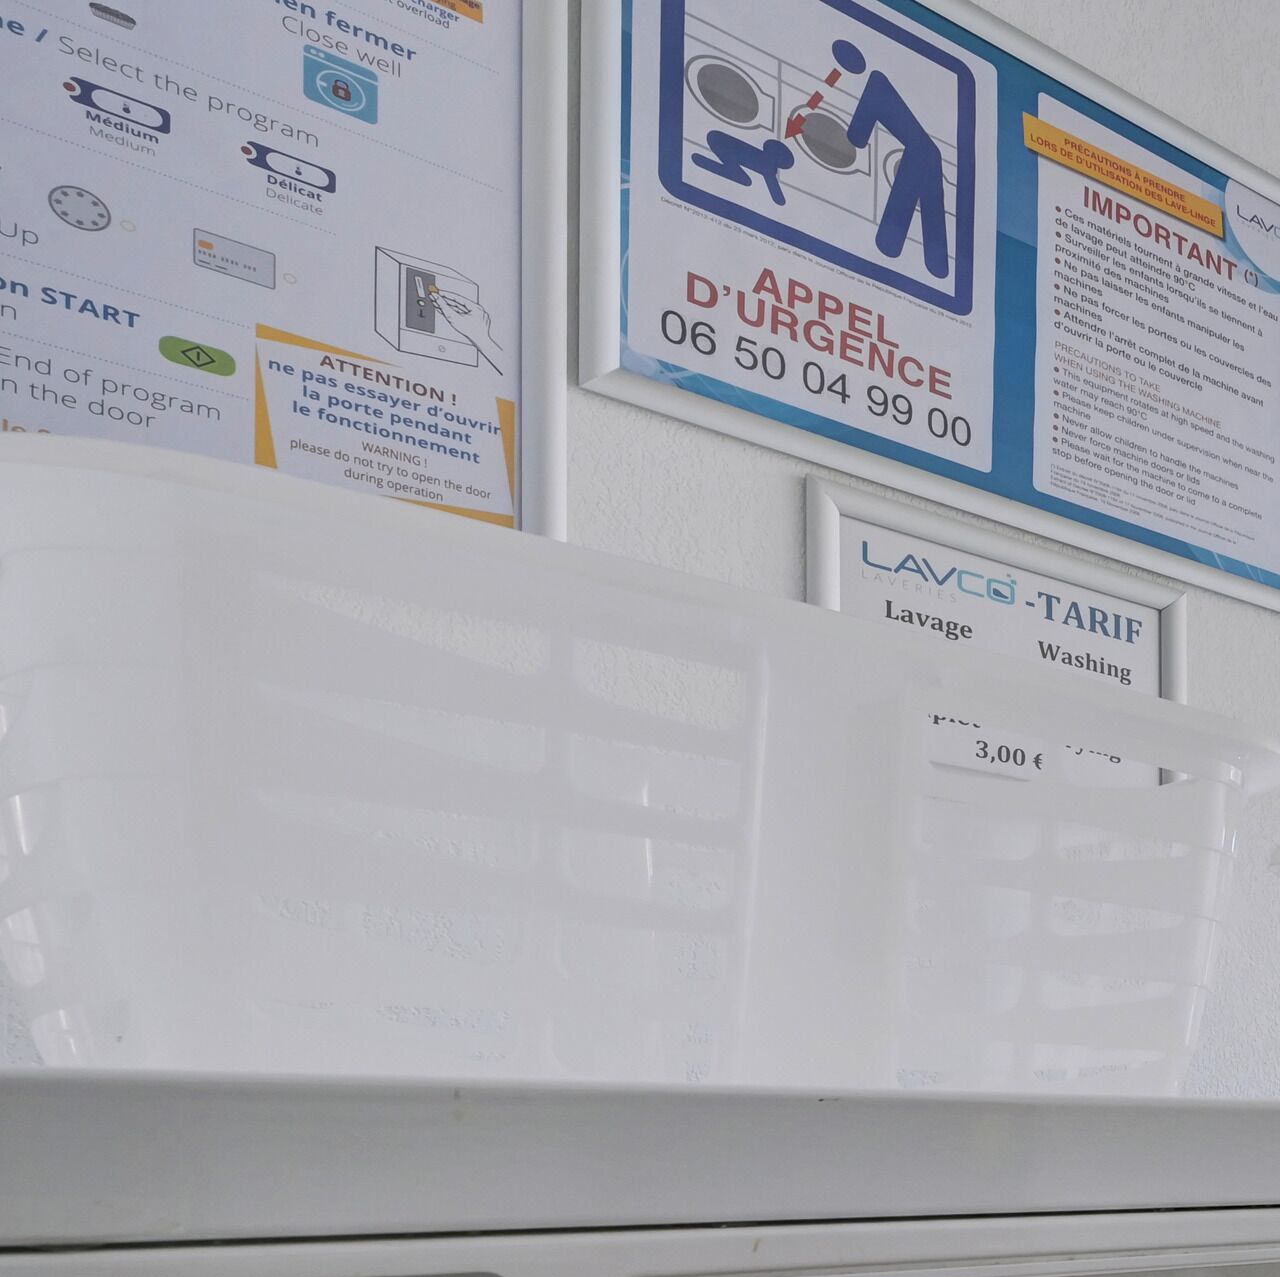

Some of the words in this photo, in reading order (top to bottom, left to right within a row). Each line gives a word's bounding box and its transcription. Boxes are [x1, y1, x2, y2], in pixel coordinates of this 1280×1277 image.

[326, 11, 417, 60] fermer
[399, 2, 450, 29] overload
[282, 15, 348, 55] Close
[357, 48, 401, 77] well
[58, 35, 145, 83] Select
[153, 73, 198, 102] the
[208, 94, 319, 148] program
[86, 109, 159, 145] Médium
[89, 125, 156, 157] Medium
[267, 174, 323, 202] Délicat
[1030, 133, 1057, 153] LORS
[1060, 147, 1073, 160] DE
[1076, 155, 1142, 192] D'UTILISATION
[1145, 187, 1163, 202] DES
[1165, 198, 1216, 227] LAVE-LINGE
[1064, 138, 1131, 177] PRÉCAUTIONS
[1143, 177, 1185, 201] PRENDRE
[266, 187, 324, 216] Delicate
[1083, 185, 1238, 281] IMPORTANT
[1065, 208, 1084, 224] Ces
[1088, 221, 1131, 248] matériels
[1134, 243, 1172, 268] tournent
[1176, 264, 1180, 272] à
[1183, 270, 1214, 289] grande
[1217, 285, 1246, 305] vitesse
[1248, 303, 1257, 311] et
[1259, 305, 1278, 322] l'eau
[41, 287, 140, 328] START
[687, 271, 953, 400] D'URGENCE
[752, 267, 899, 349] APPEL
[0, 346, 51, 376] End
[64, 369, 92, 386] of
[103, 378, 221, 421] program
[29, 383, 77, 409] the
[89, 400, 155, 428] door
[269, 360, 294, 376] ne
[302, 369, 337, 388] pas
[345, 383, 421, 411] essayer
[320, 355, 444, 403] ATTENTION
[661, 309, 716, 355] 06
[734, 335, 785, 380] 50
[802, 361, 850, 405] 04
[867, 384, 912, 426] 99
[927, 407, 971, 447] 00
[293, 400, 310, 415] le
[318, 408, 480, 464] fonctionnement
[303, 385, 320, 400] la
[328, 396, 383, 419] porte
[390, 413, 472, 445] pendant
[290, 439, 330, 457] please
[334, 450, 350, 462] do
[354, 456, 373, 469] not
[378, 461, 393, 475] try
[397, 466, 408, 477] to
[412, 471, 440, 486] open
[444, 479, 462, 492] the
[465, 484, 491, 500] door
[362, 440, 421, 466] WARNING
[345, 468, 383, 488] during
[387, 479, 444, 502] operation
[885, 600, 973, 641] Lavage
[1038, 641, 1131, 684] Washing
[975, 740, 1026, 767] 3,00
[1032, 752, 1043, 770] €
